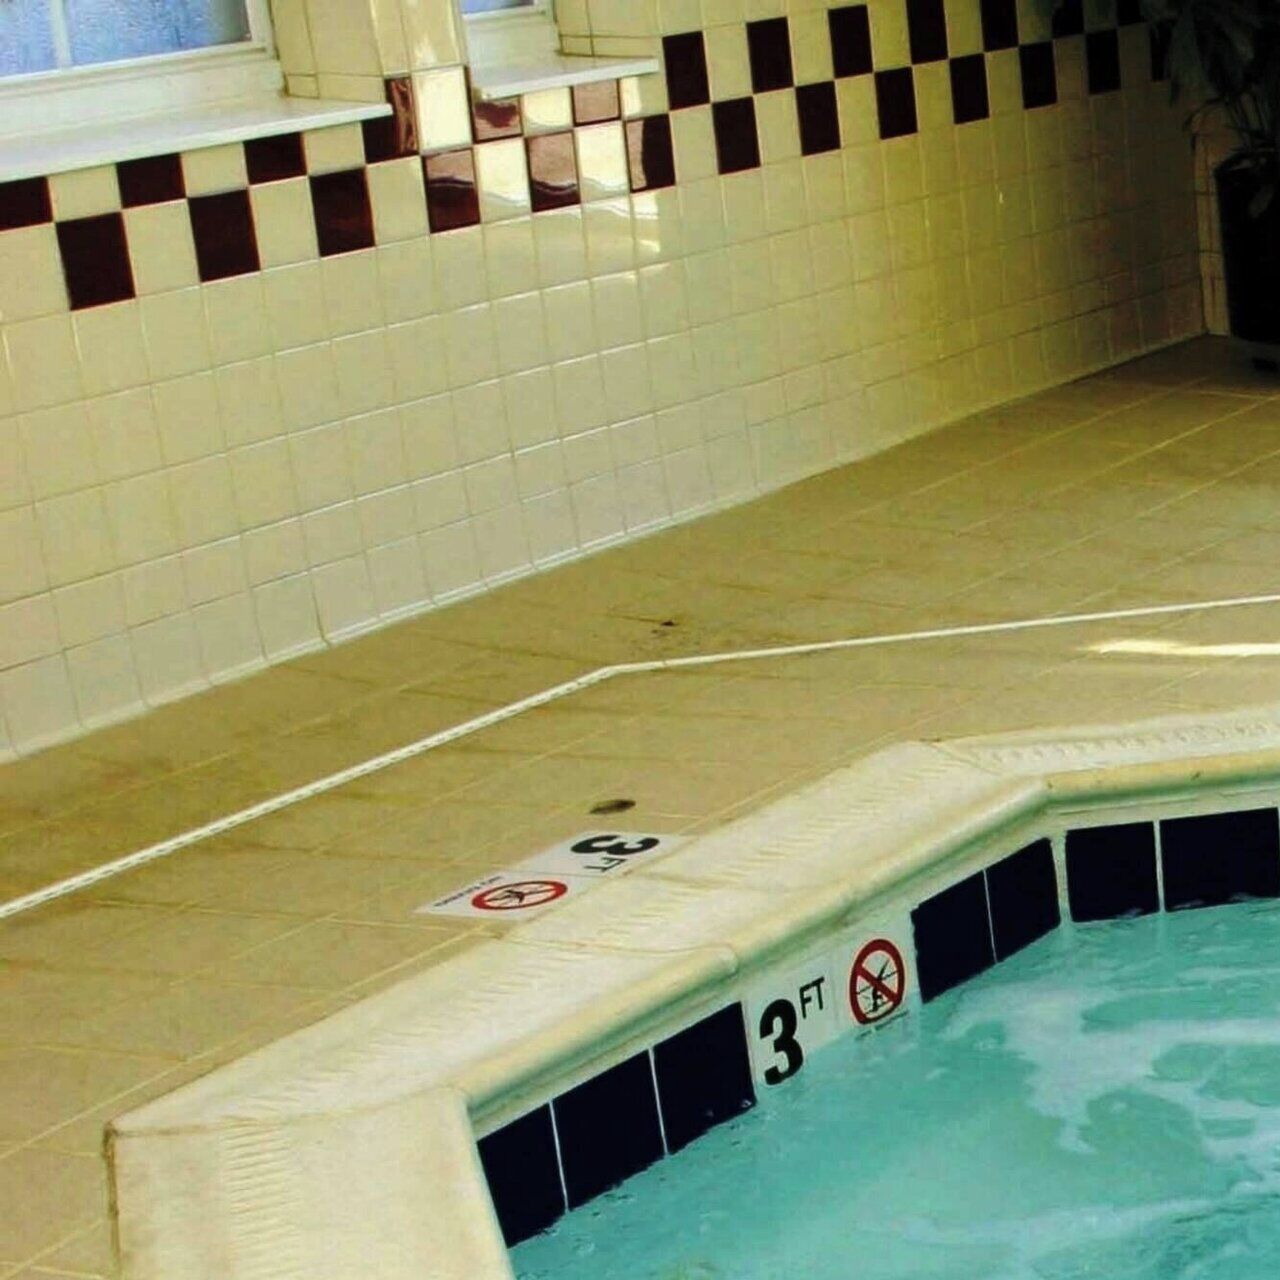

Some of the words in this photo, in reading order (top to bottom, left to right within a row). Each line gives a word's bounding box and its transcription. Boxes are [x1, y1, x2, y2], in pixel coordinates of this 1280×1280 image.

[570, 835, 660, 856] 3
[759, 999, 804, 1086] 3
[799, 976, 825, 1020] FT
